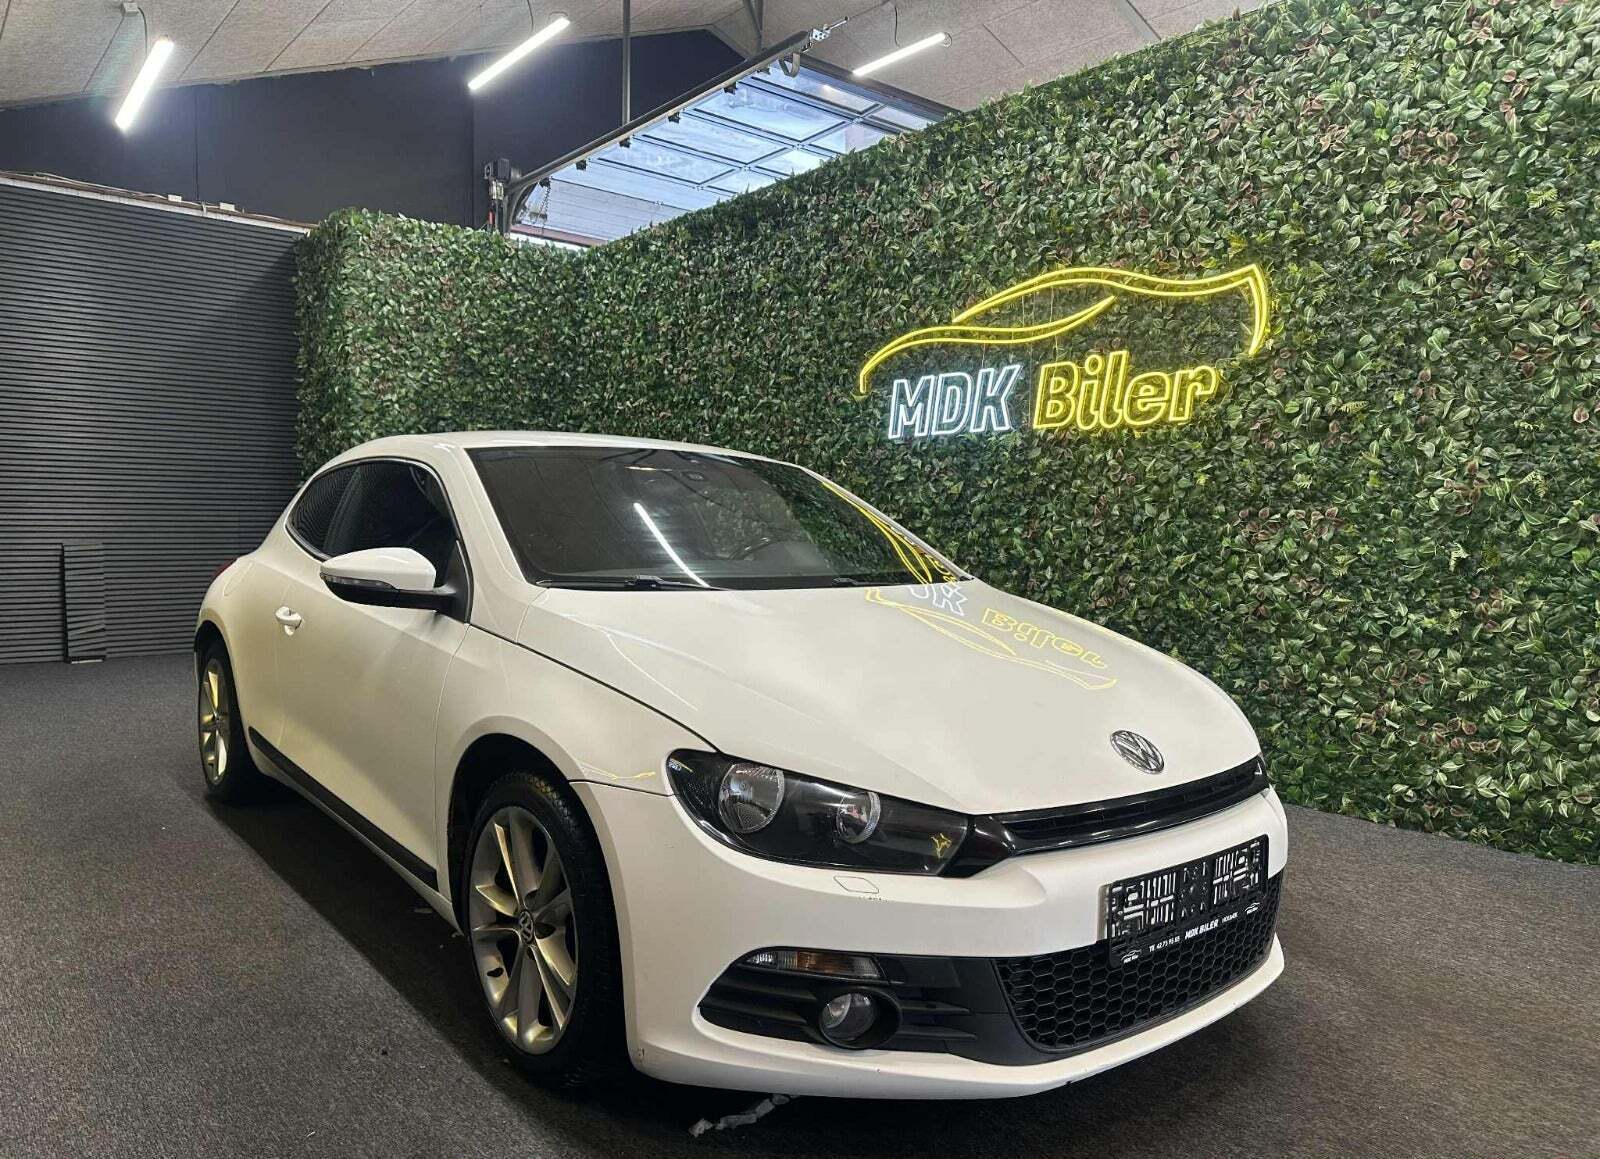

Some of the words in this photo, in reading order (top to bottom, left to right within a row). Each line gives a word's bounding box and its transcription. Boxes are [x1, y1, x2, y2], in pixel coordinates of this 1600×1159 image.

[887, 363, 1022, 439] MDK
[1033, 350, 1220, 431] Biler
[1199, 919, 1219, 934] BILER
